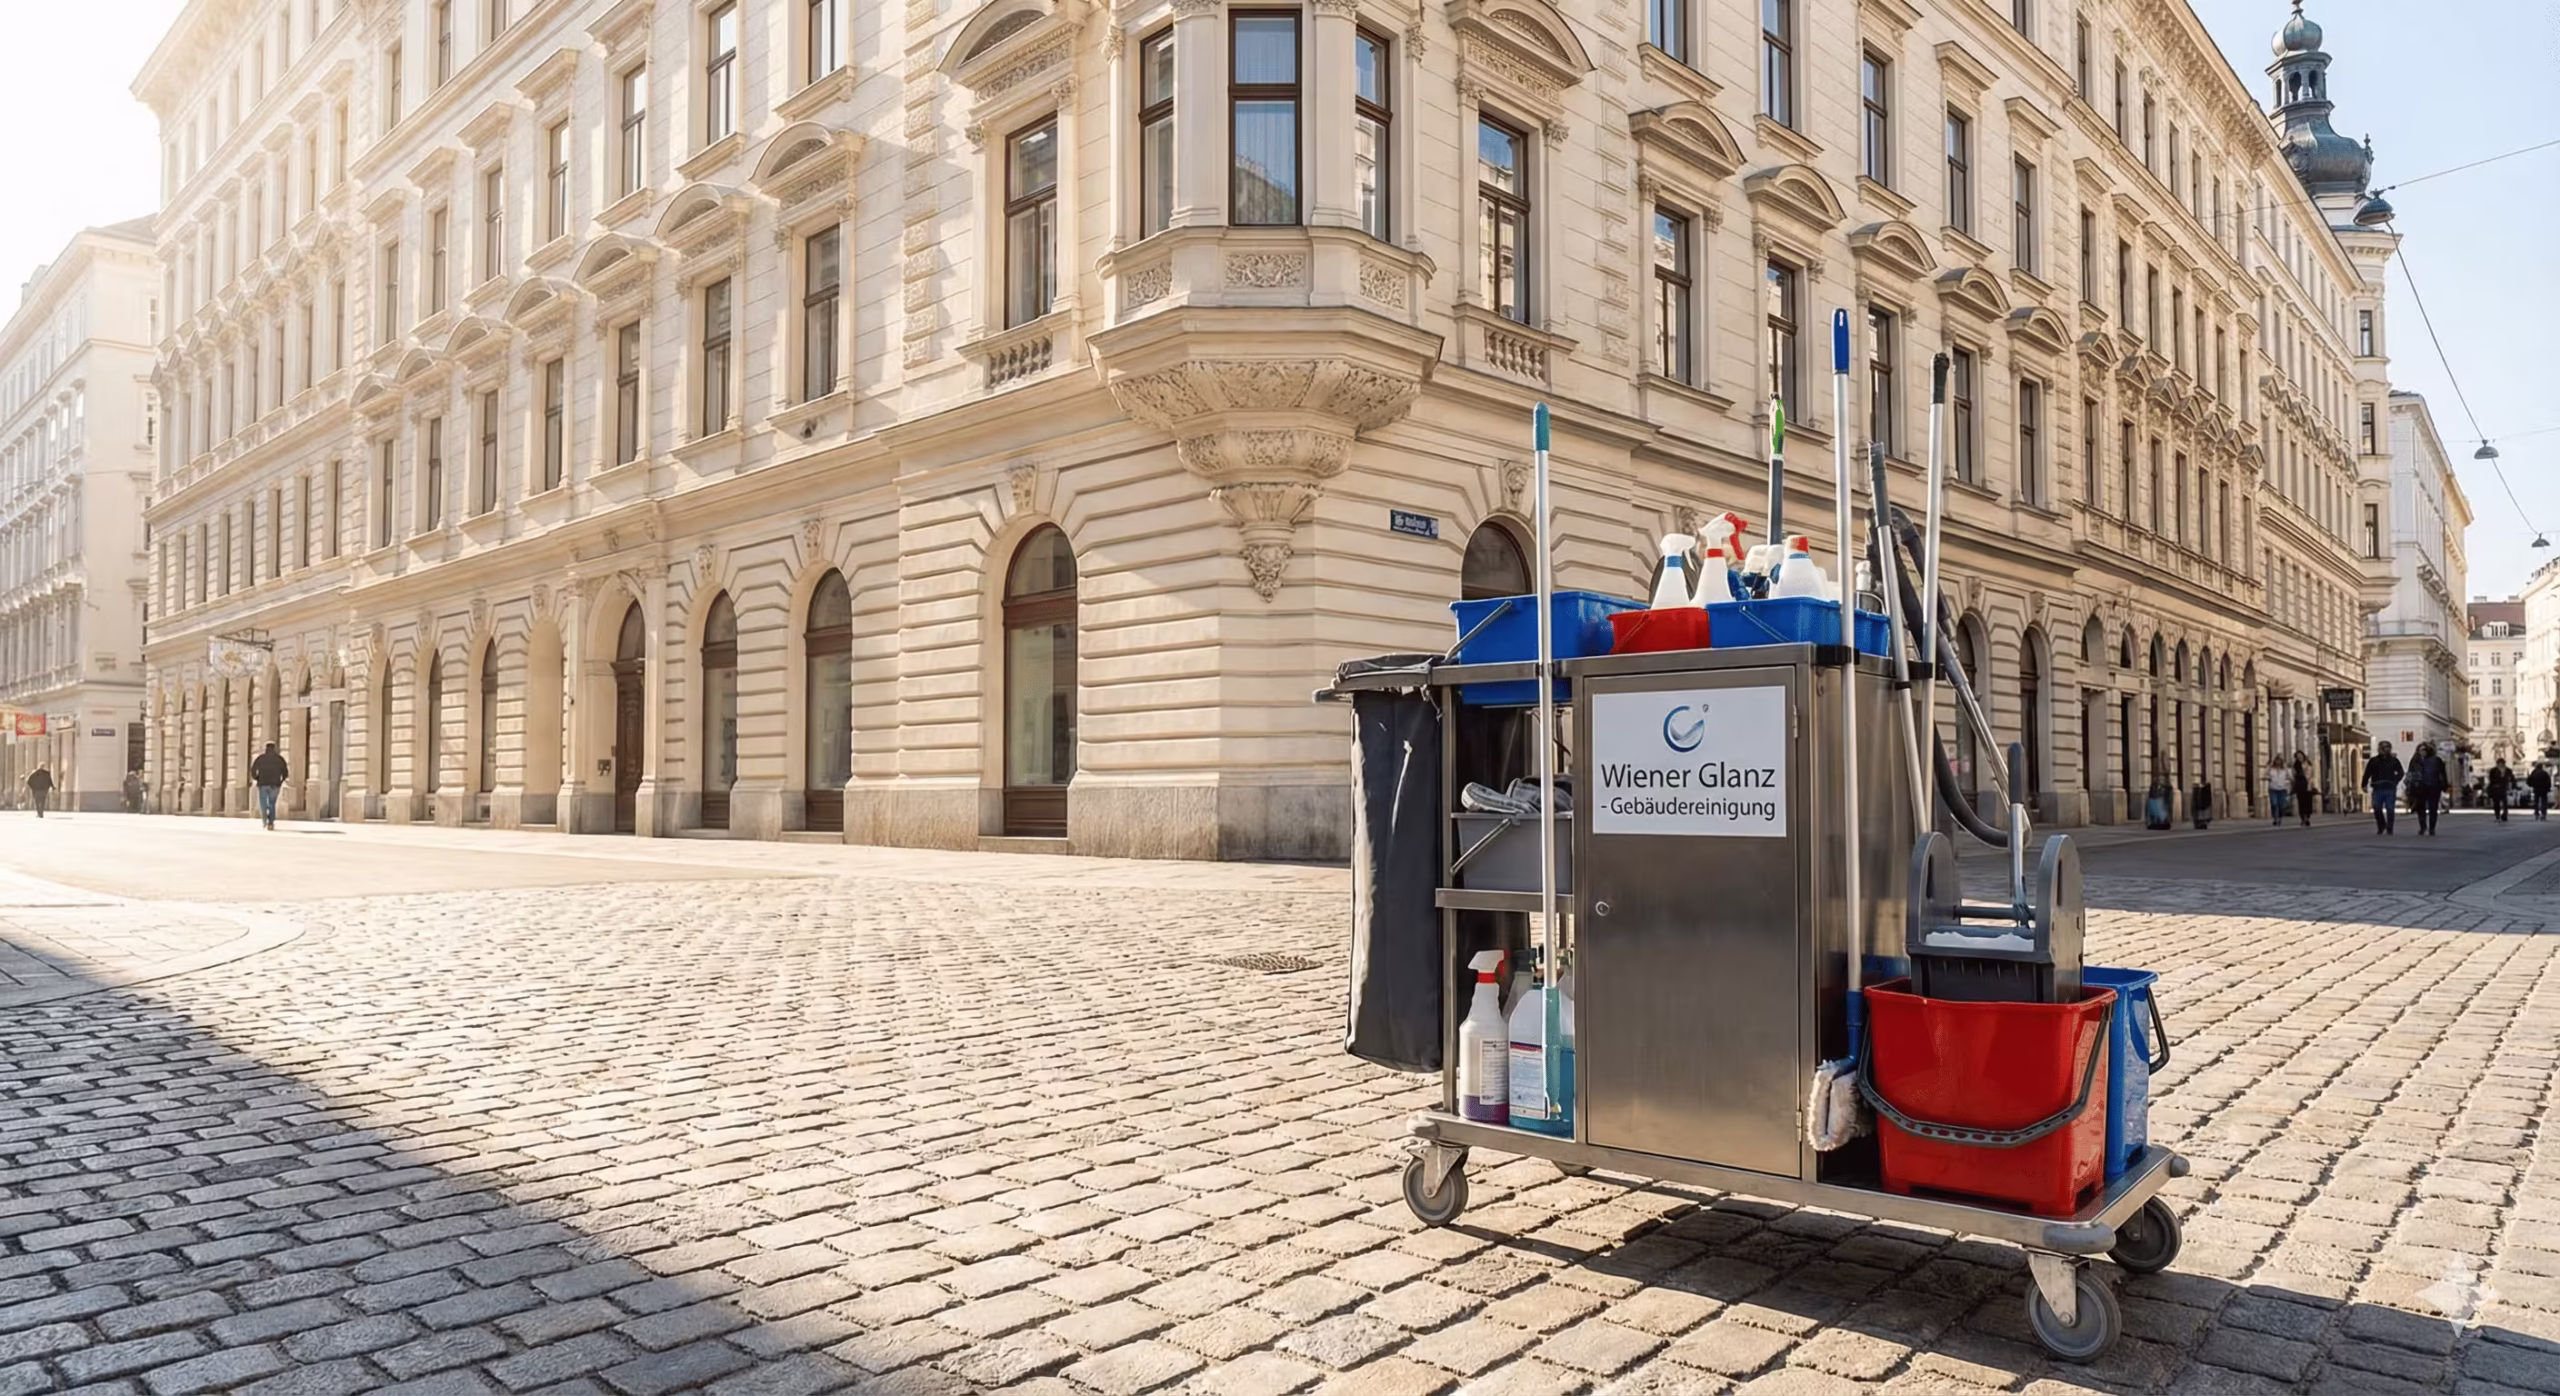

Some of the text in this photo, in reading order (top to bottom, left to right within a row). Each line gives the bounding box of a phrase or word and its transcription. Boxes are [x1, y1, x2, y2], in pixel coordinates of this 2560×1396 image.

[1601, 761, 1775, 788] Wiener Glanz
[1610, 797, 1775, 821] Gebäudereinigung
